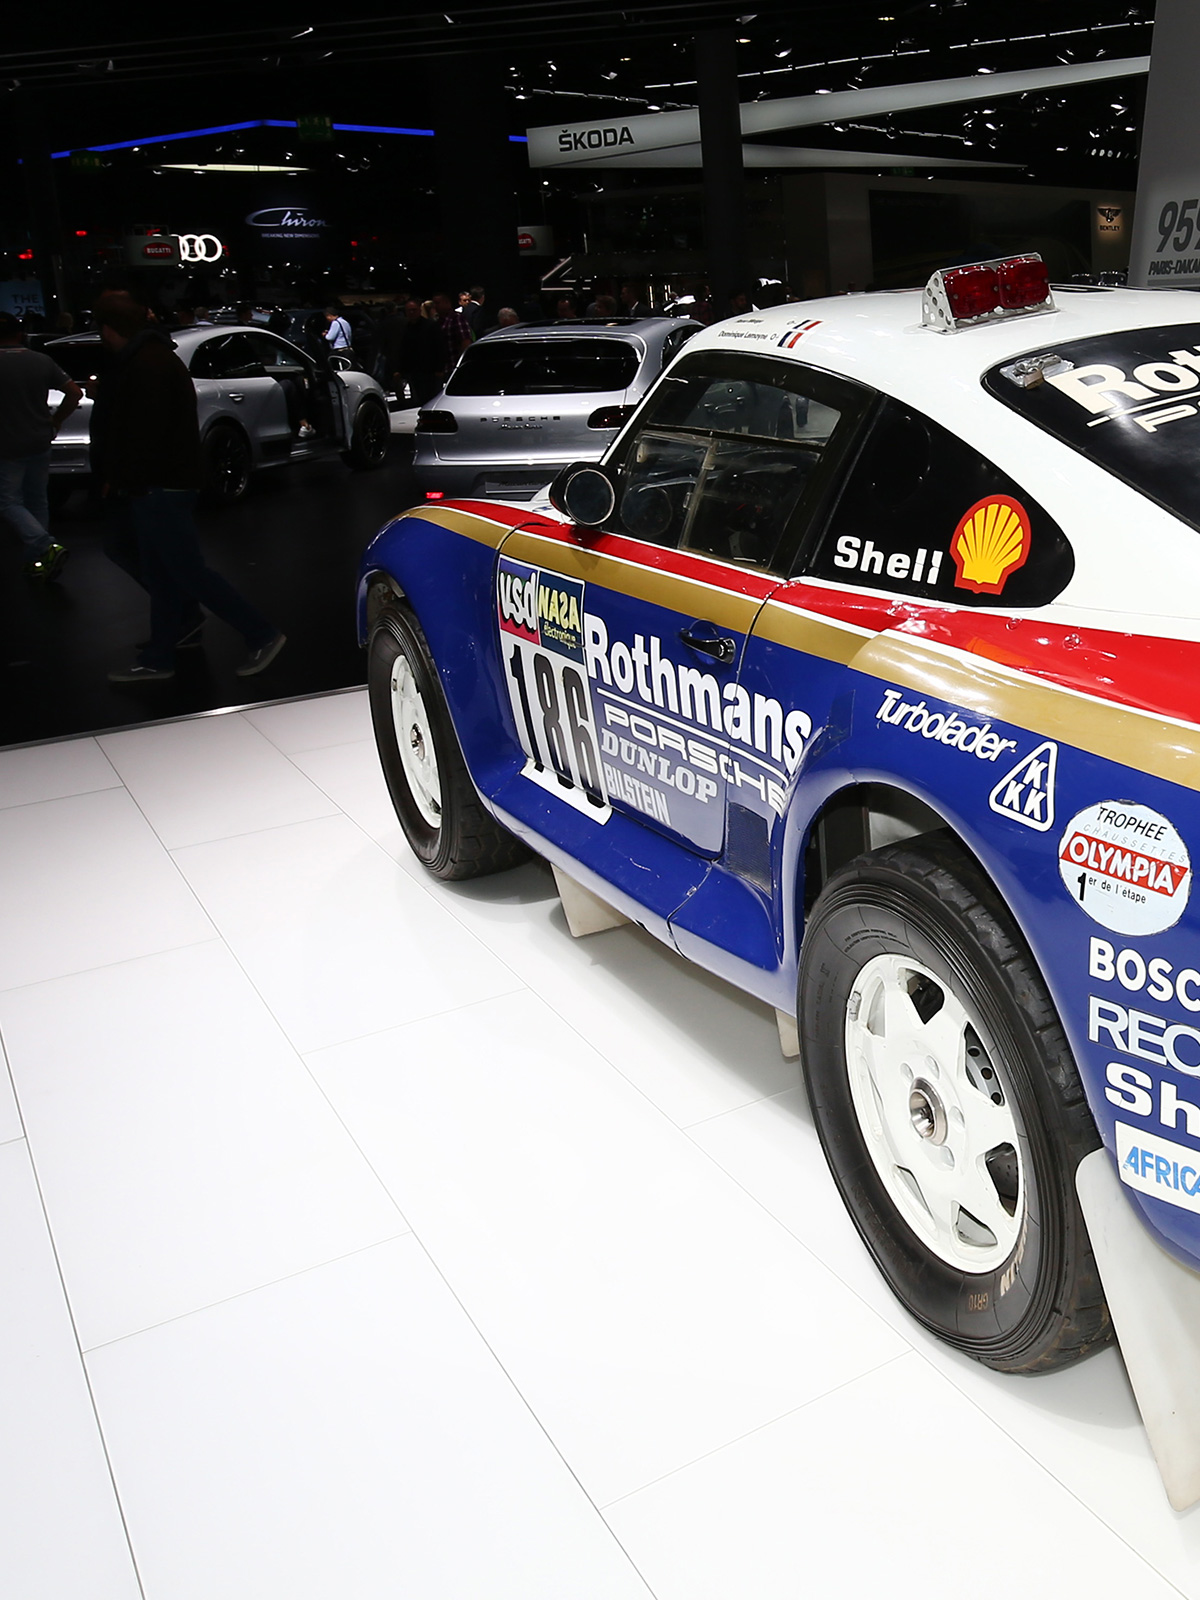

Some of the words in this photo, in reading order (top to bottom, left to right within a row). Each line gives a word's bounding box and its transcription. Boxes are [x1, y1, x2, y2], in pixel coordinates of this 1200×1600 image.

[558, 128, 635, 152] ŠKODA
[833, 535, 944, 585] Shell
[509, 643, 606, 809] 186
[584, 612, 812, 776] Rothmans
[874, 688, 1018, 762] Turbolader
[601, 727, 719, 804] DUNLOP
[603, 703, 790, 820] PORSCHE
[603, 761, 673, 827] BILSTEIN
[1083, 823, 1187, 864] CHAUSSETTES
[1096, 806, 1168, 842] TROPHEE
[1068, 835, 1175, 895] OLYMPIA
